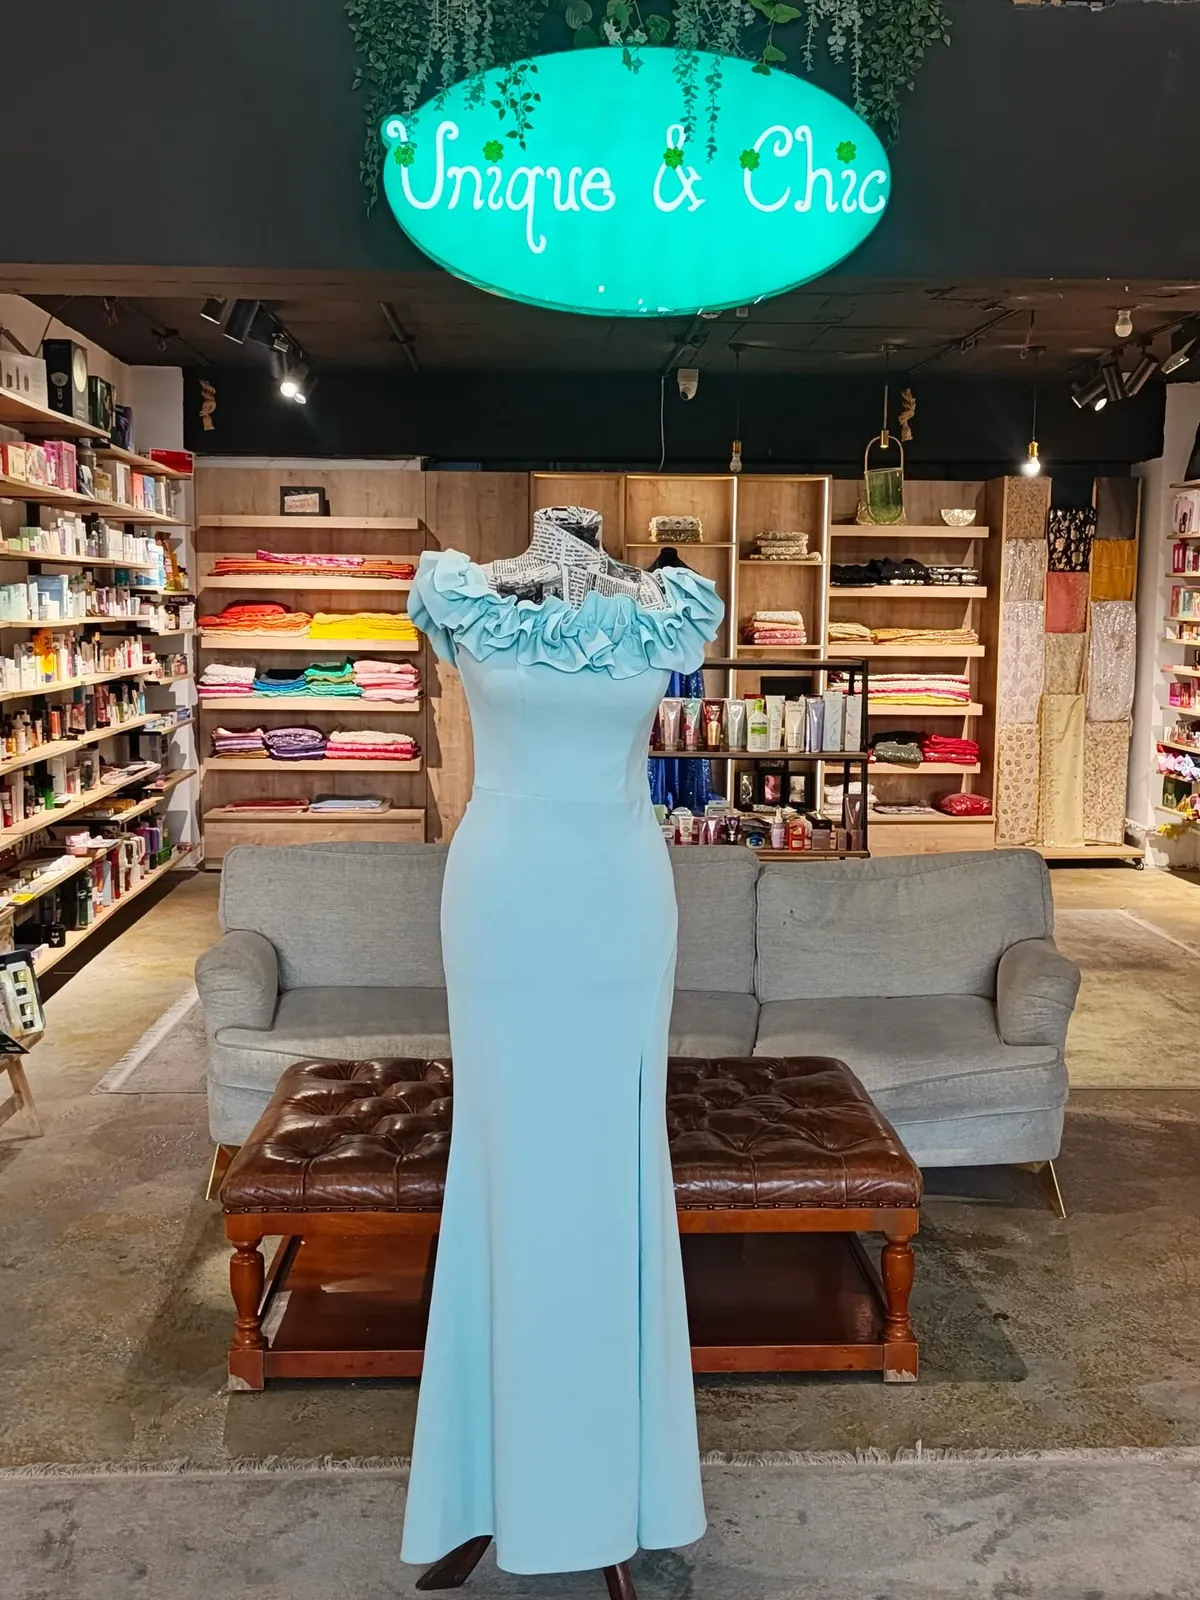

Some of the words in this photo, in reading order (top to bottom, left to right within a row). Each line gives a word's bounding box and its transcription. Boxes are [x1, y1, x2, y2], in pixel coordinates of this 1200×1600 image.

[386, 119, 616, 254] Unique
[653, 123, 706, 213] &
[743, 124, 888, 214] Chic
